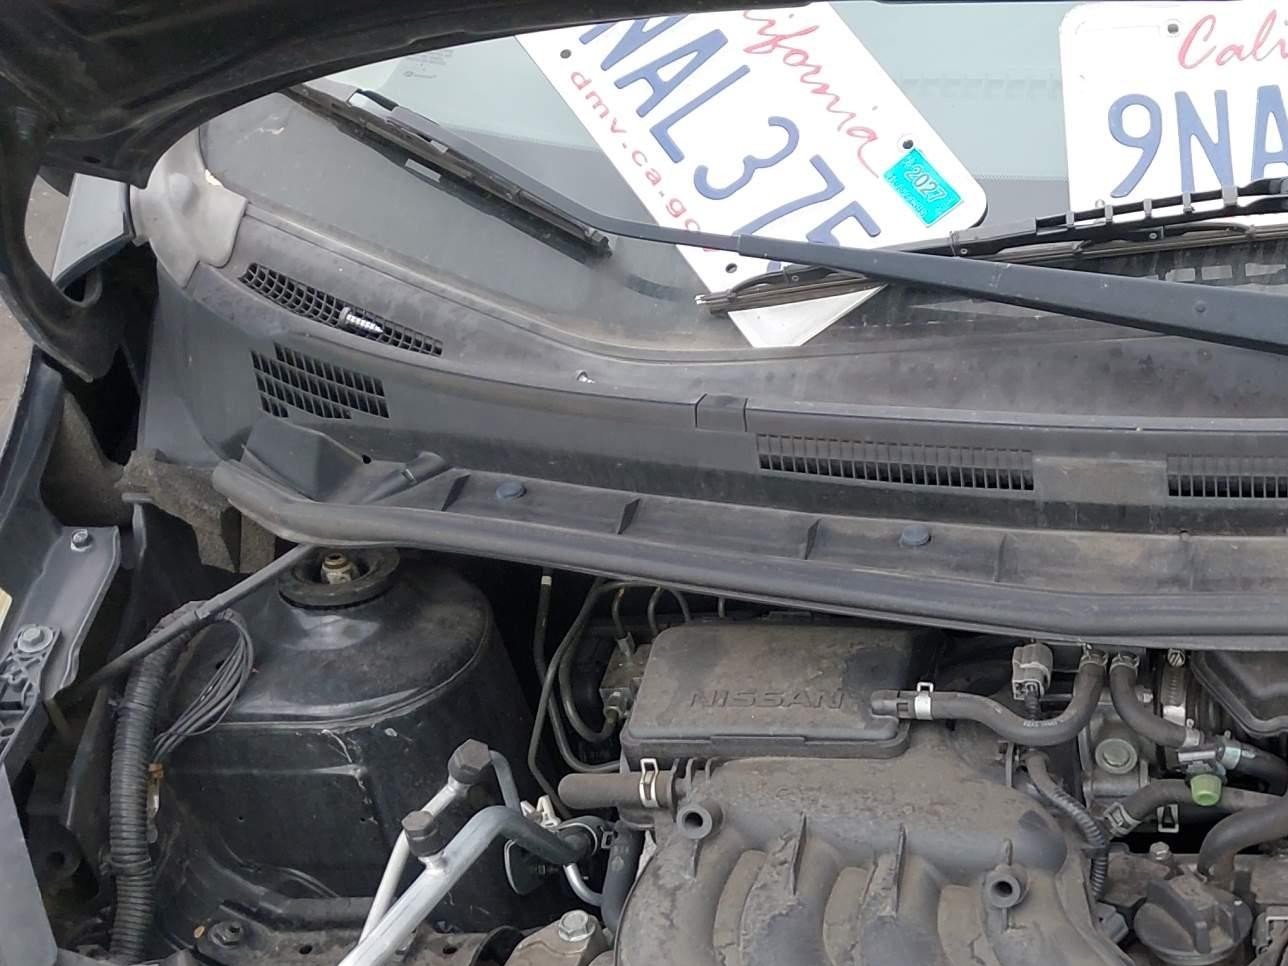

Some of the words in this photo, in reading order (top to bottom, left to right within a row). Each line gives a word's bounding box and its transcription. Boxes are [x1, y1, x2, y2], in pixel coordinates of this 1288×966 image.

[743, 10, 879, 178] ifornia
[570, 71, 719, 251] dmv.ca.go
[904, 165, 946, 203] 2027
[689, 689, 845, 710] NISSAN
